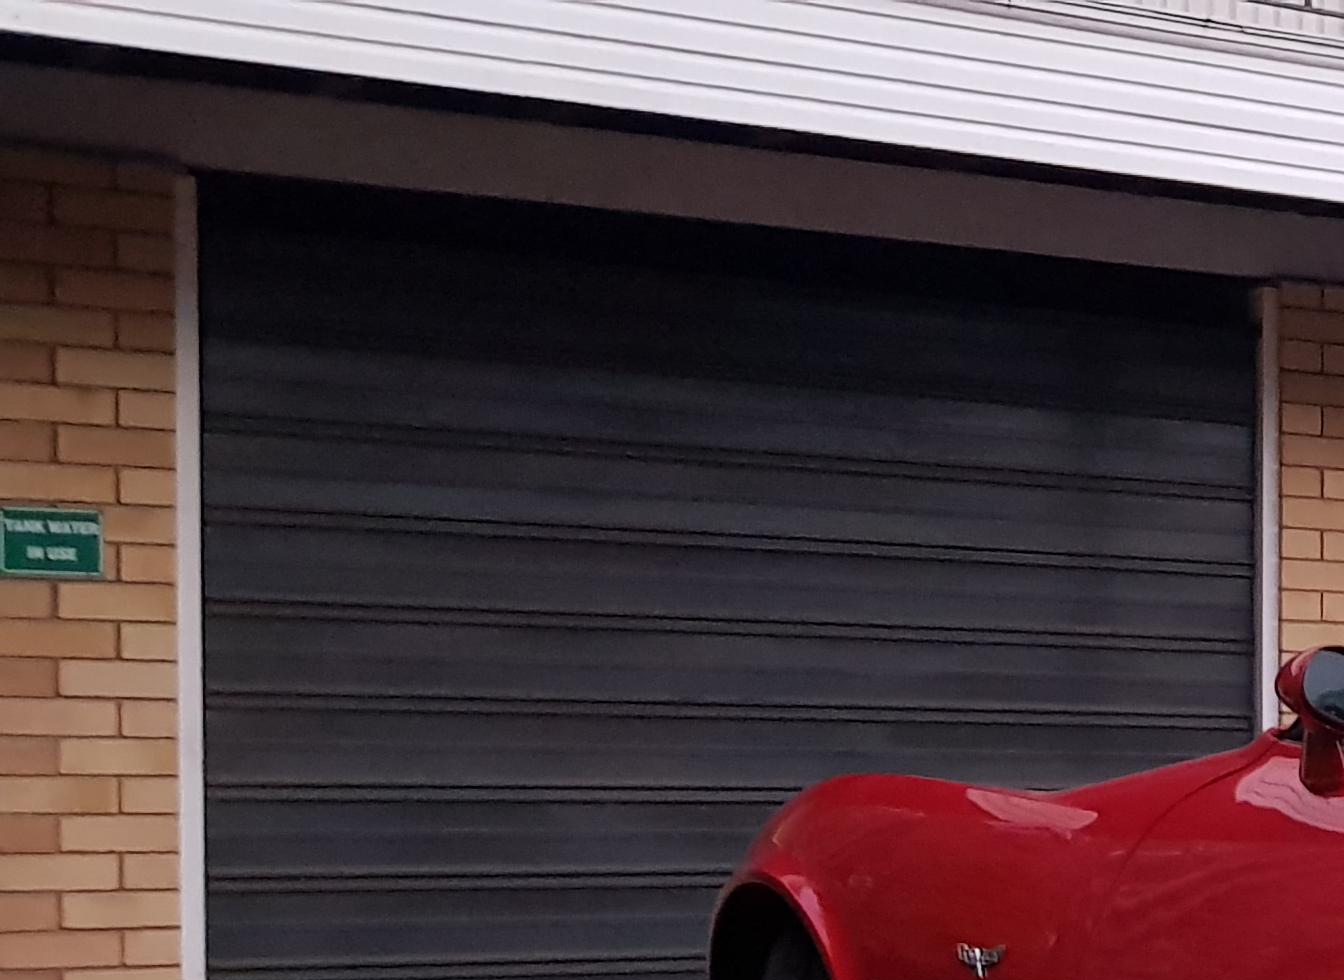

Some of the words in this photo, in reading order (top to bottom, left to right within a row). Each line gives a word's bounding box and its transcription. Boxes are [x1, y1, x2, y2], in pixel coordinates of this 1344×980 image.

[4, 518, 46, 533] TANK
[48, 520, 99, 535] WATER
[46, 546, 78, 561] USE
